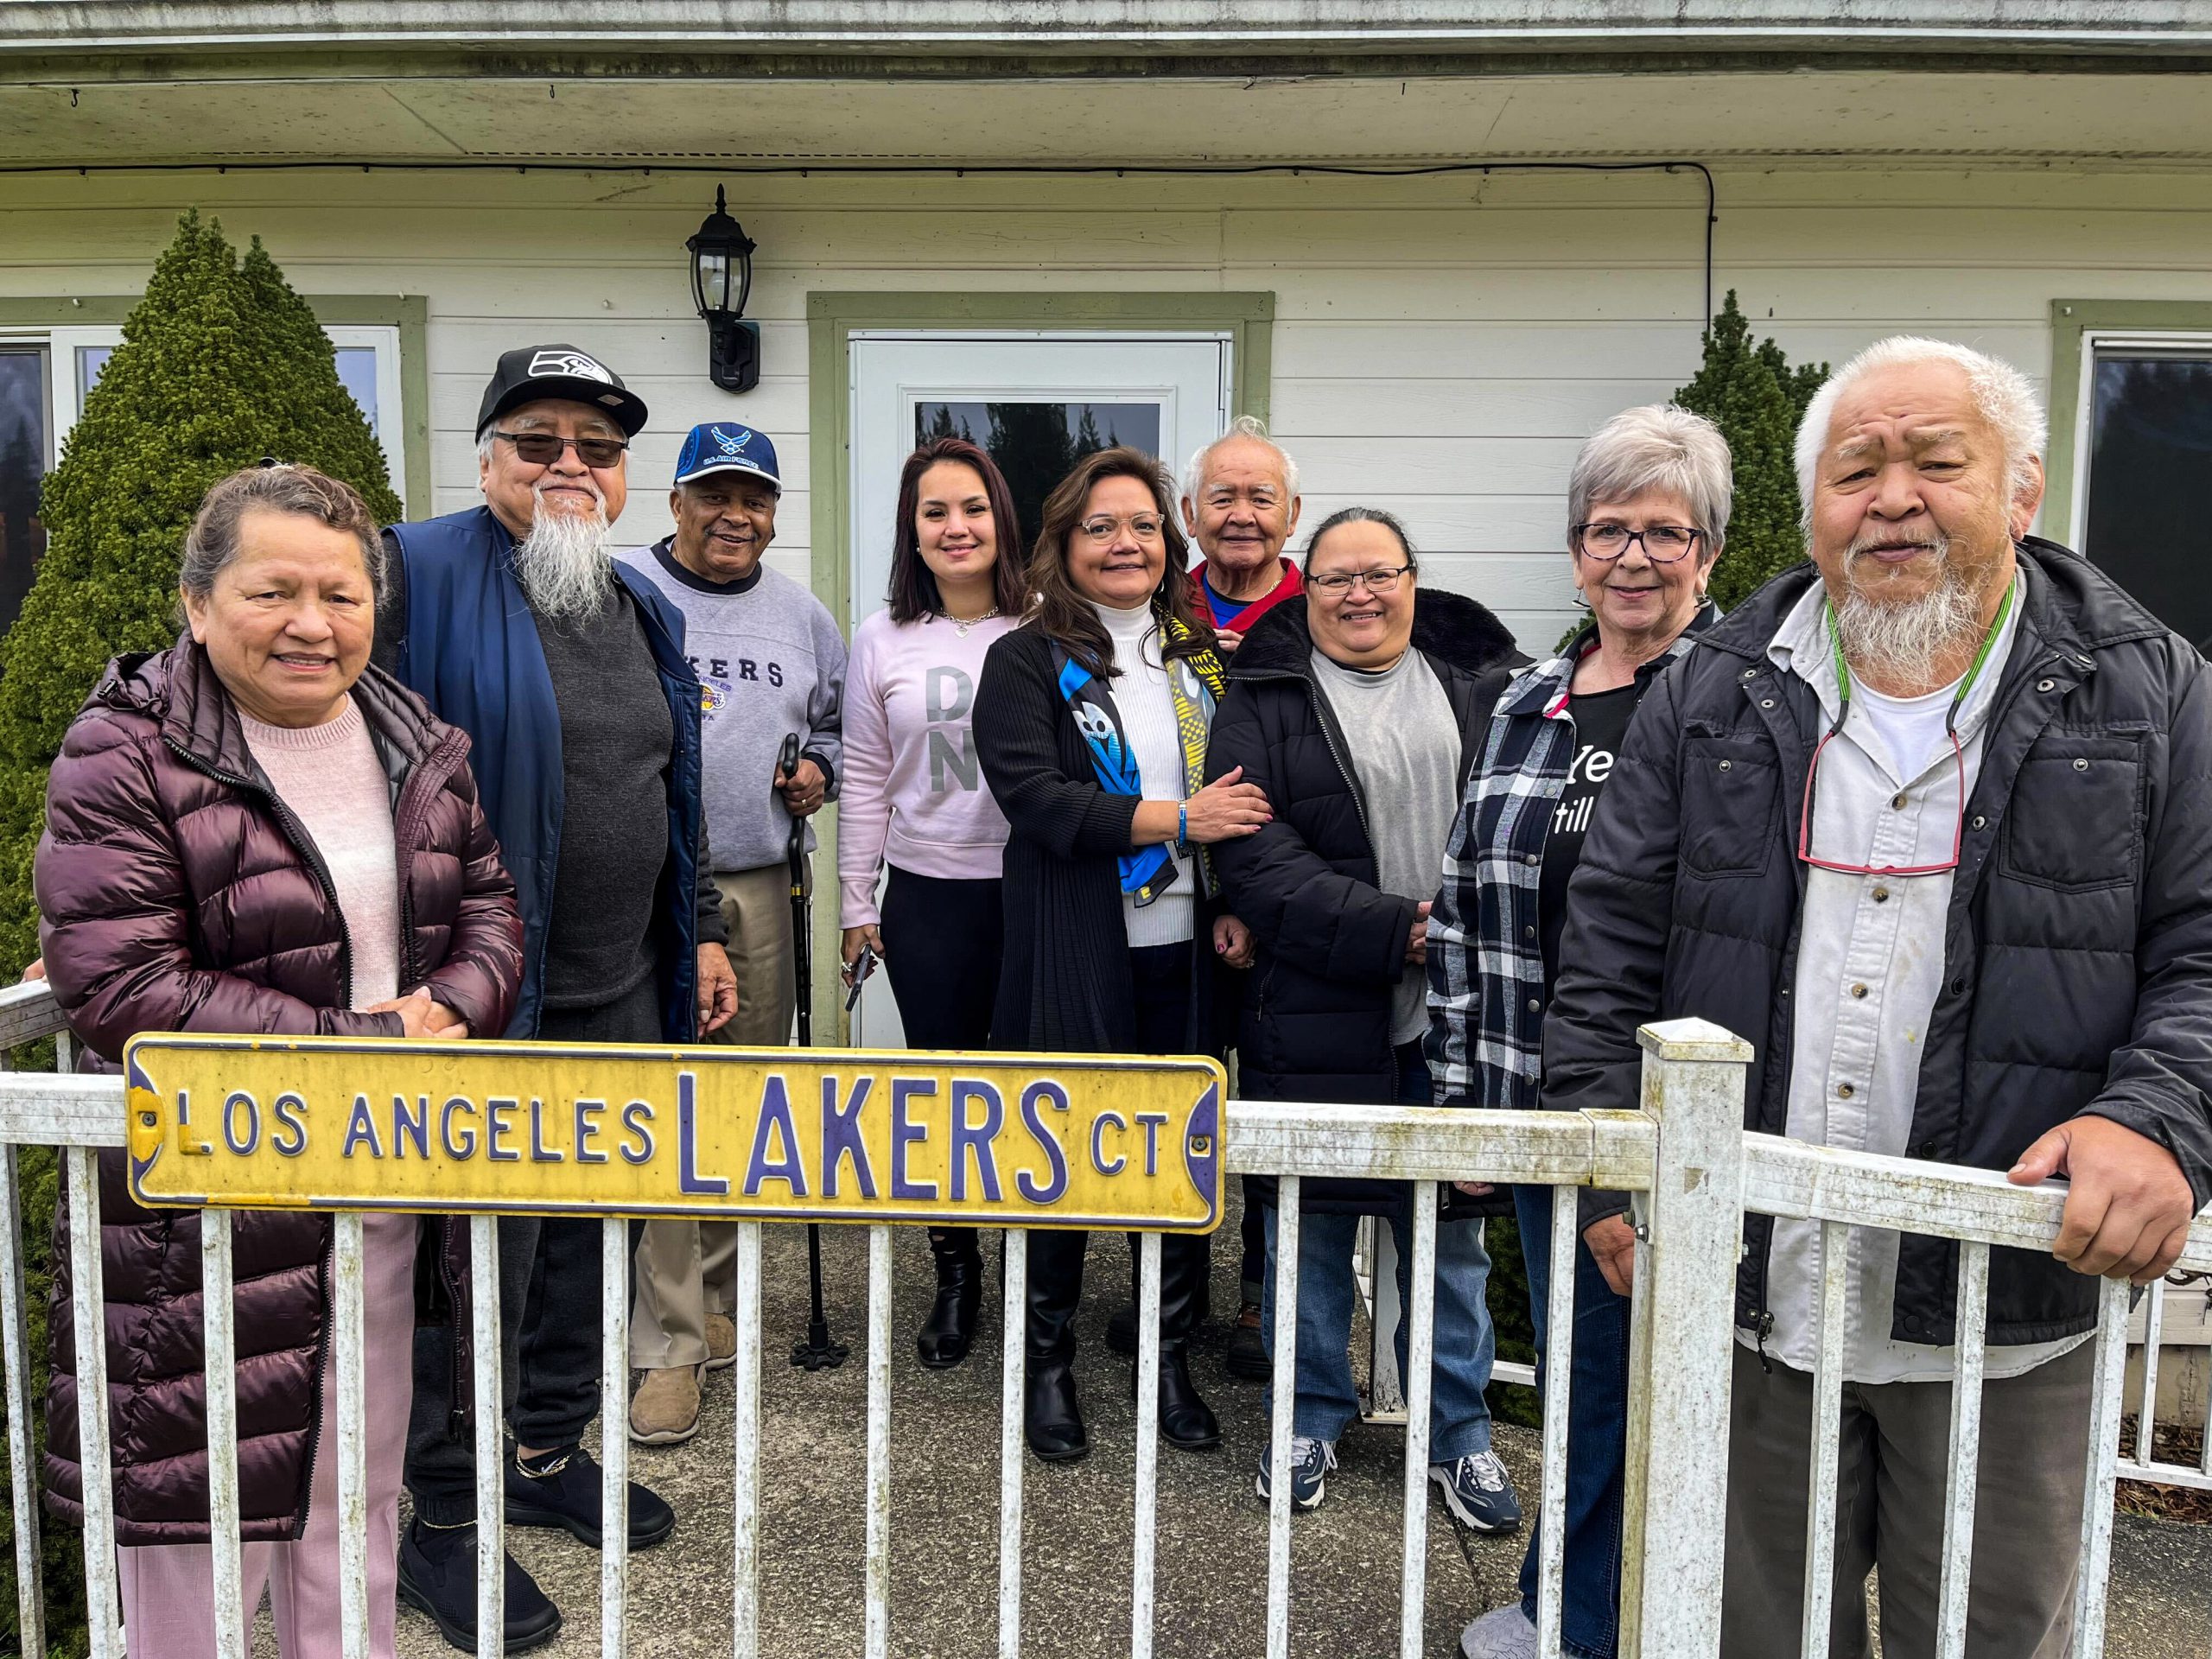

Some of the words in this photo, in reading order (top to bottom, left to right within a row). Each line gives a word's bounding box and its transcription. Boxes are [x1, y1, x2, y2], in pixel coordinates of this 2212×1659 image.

[731, 455, 759, 469] FORCE
[925, 665, 973, 722] D
[928, 729, 978, 792] N
[1554, 796, 1594, 834] till
[178, 1089, 308, 1157] LOS
[342, 1091, 656, 1165] ANGELES
[677, 1071, 1071, 1205] LAKERS
[1090, 1110, 1169, 1176] CT
